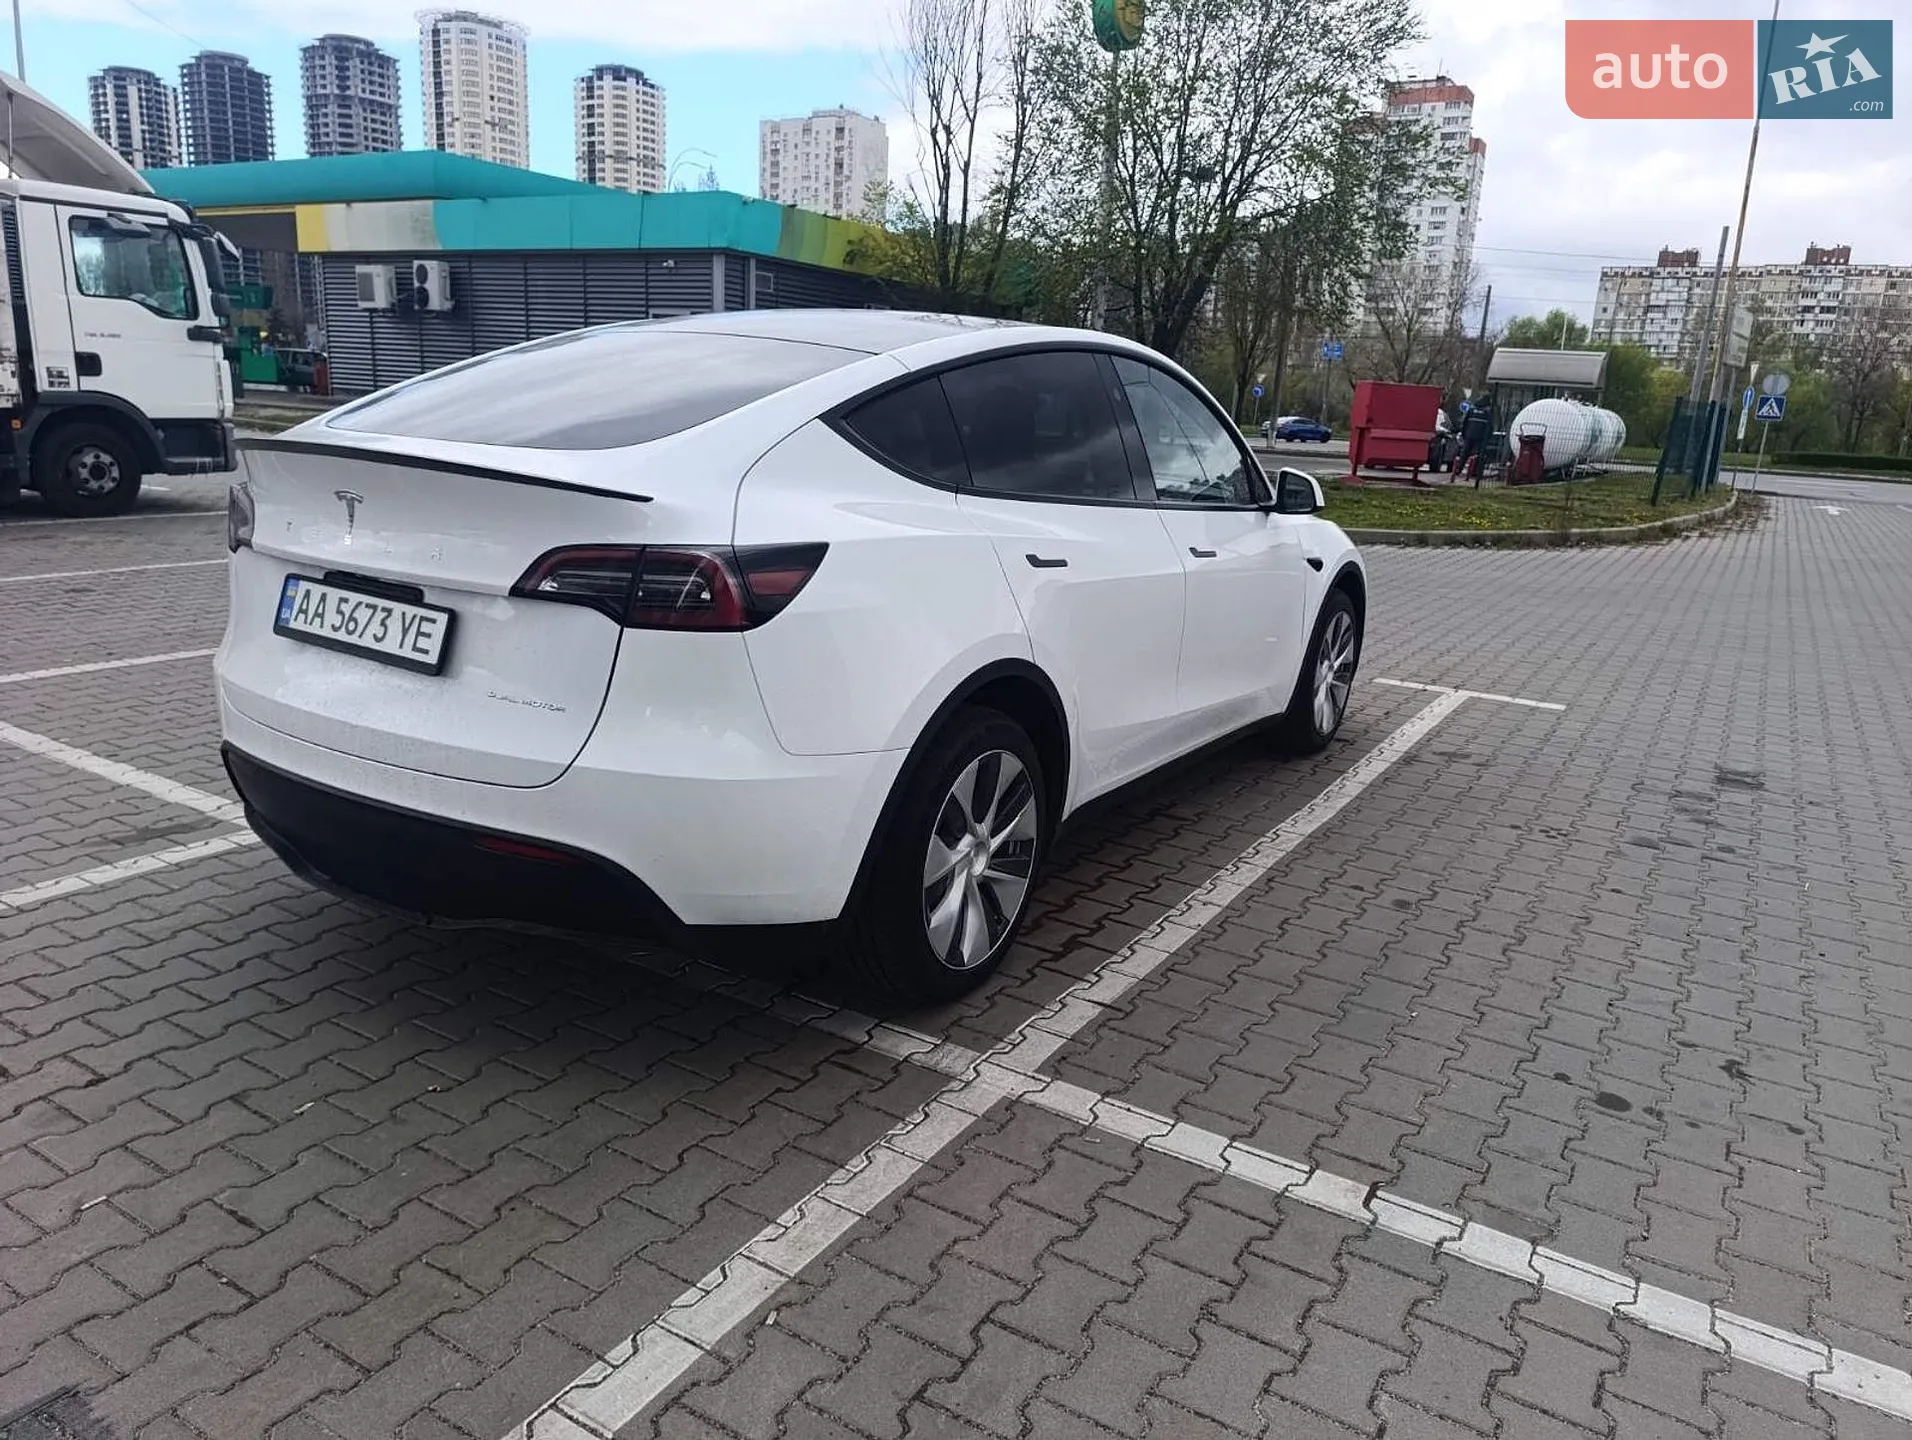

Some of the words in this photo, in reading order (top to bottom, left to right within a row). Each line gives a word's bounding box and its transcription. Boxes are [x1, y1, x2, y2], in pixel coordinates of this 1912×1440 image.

[293, 588, 328, 629] AA
[331, 597, 394, 643] 5673
[398, 611, 438, 655] YE
